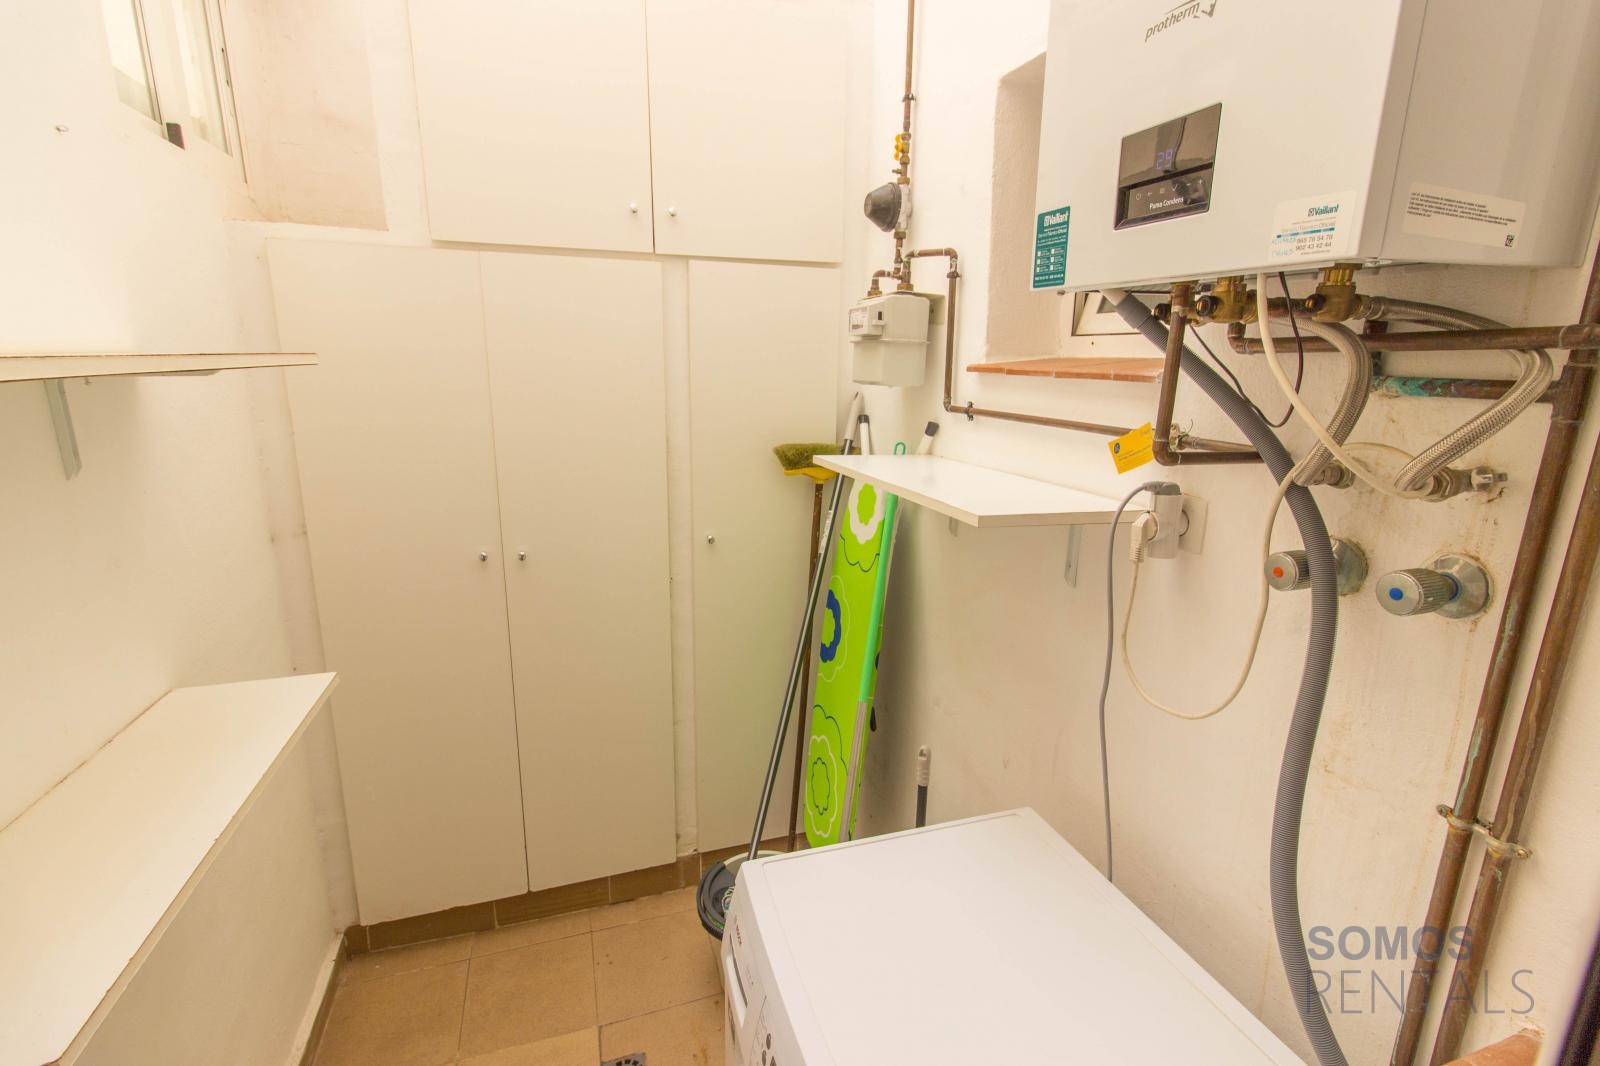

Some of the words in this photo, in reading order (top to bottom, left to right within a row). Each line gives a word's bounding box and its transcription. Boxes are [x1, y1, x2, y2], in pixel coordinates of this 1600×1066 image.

[1144, 1, 1200, 43] protherm
[1149, 201, 1163, 210] Puma
[1314, 203, 1339, 216] Vaillant
